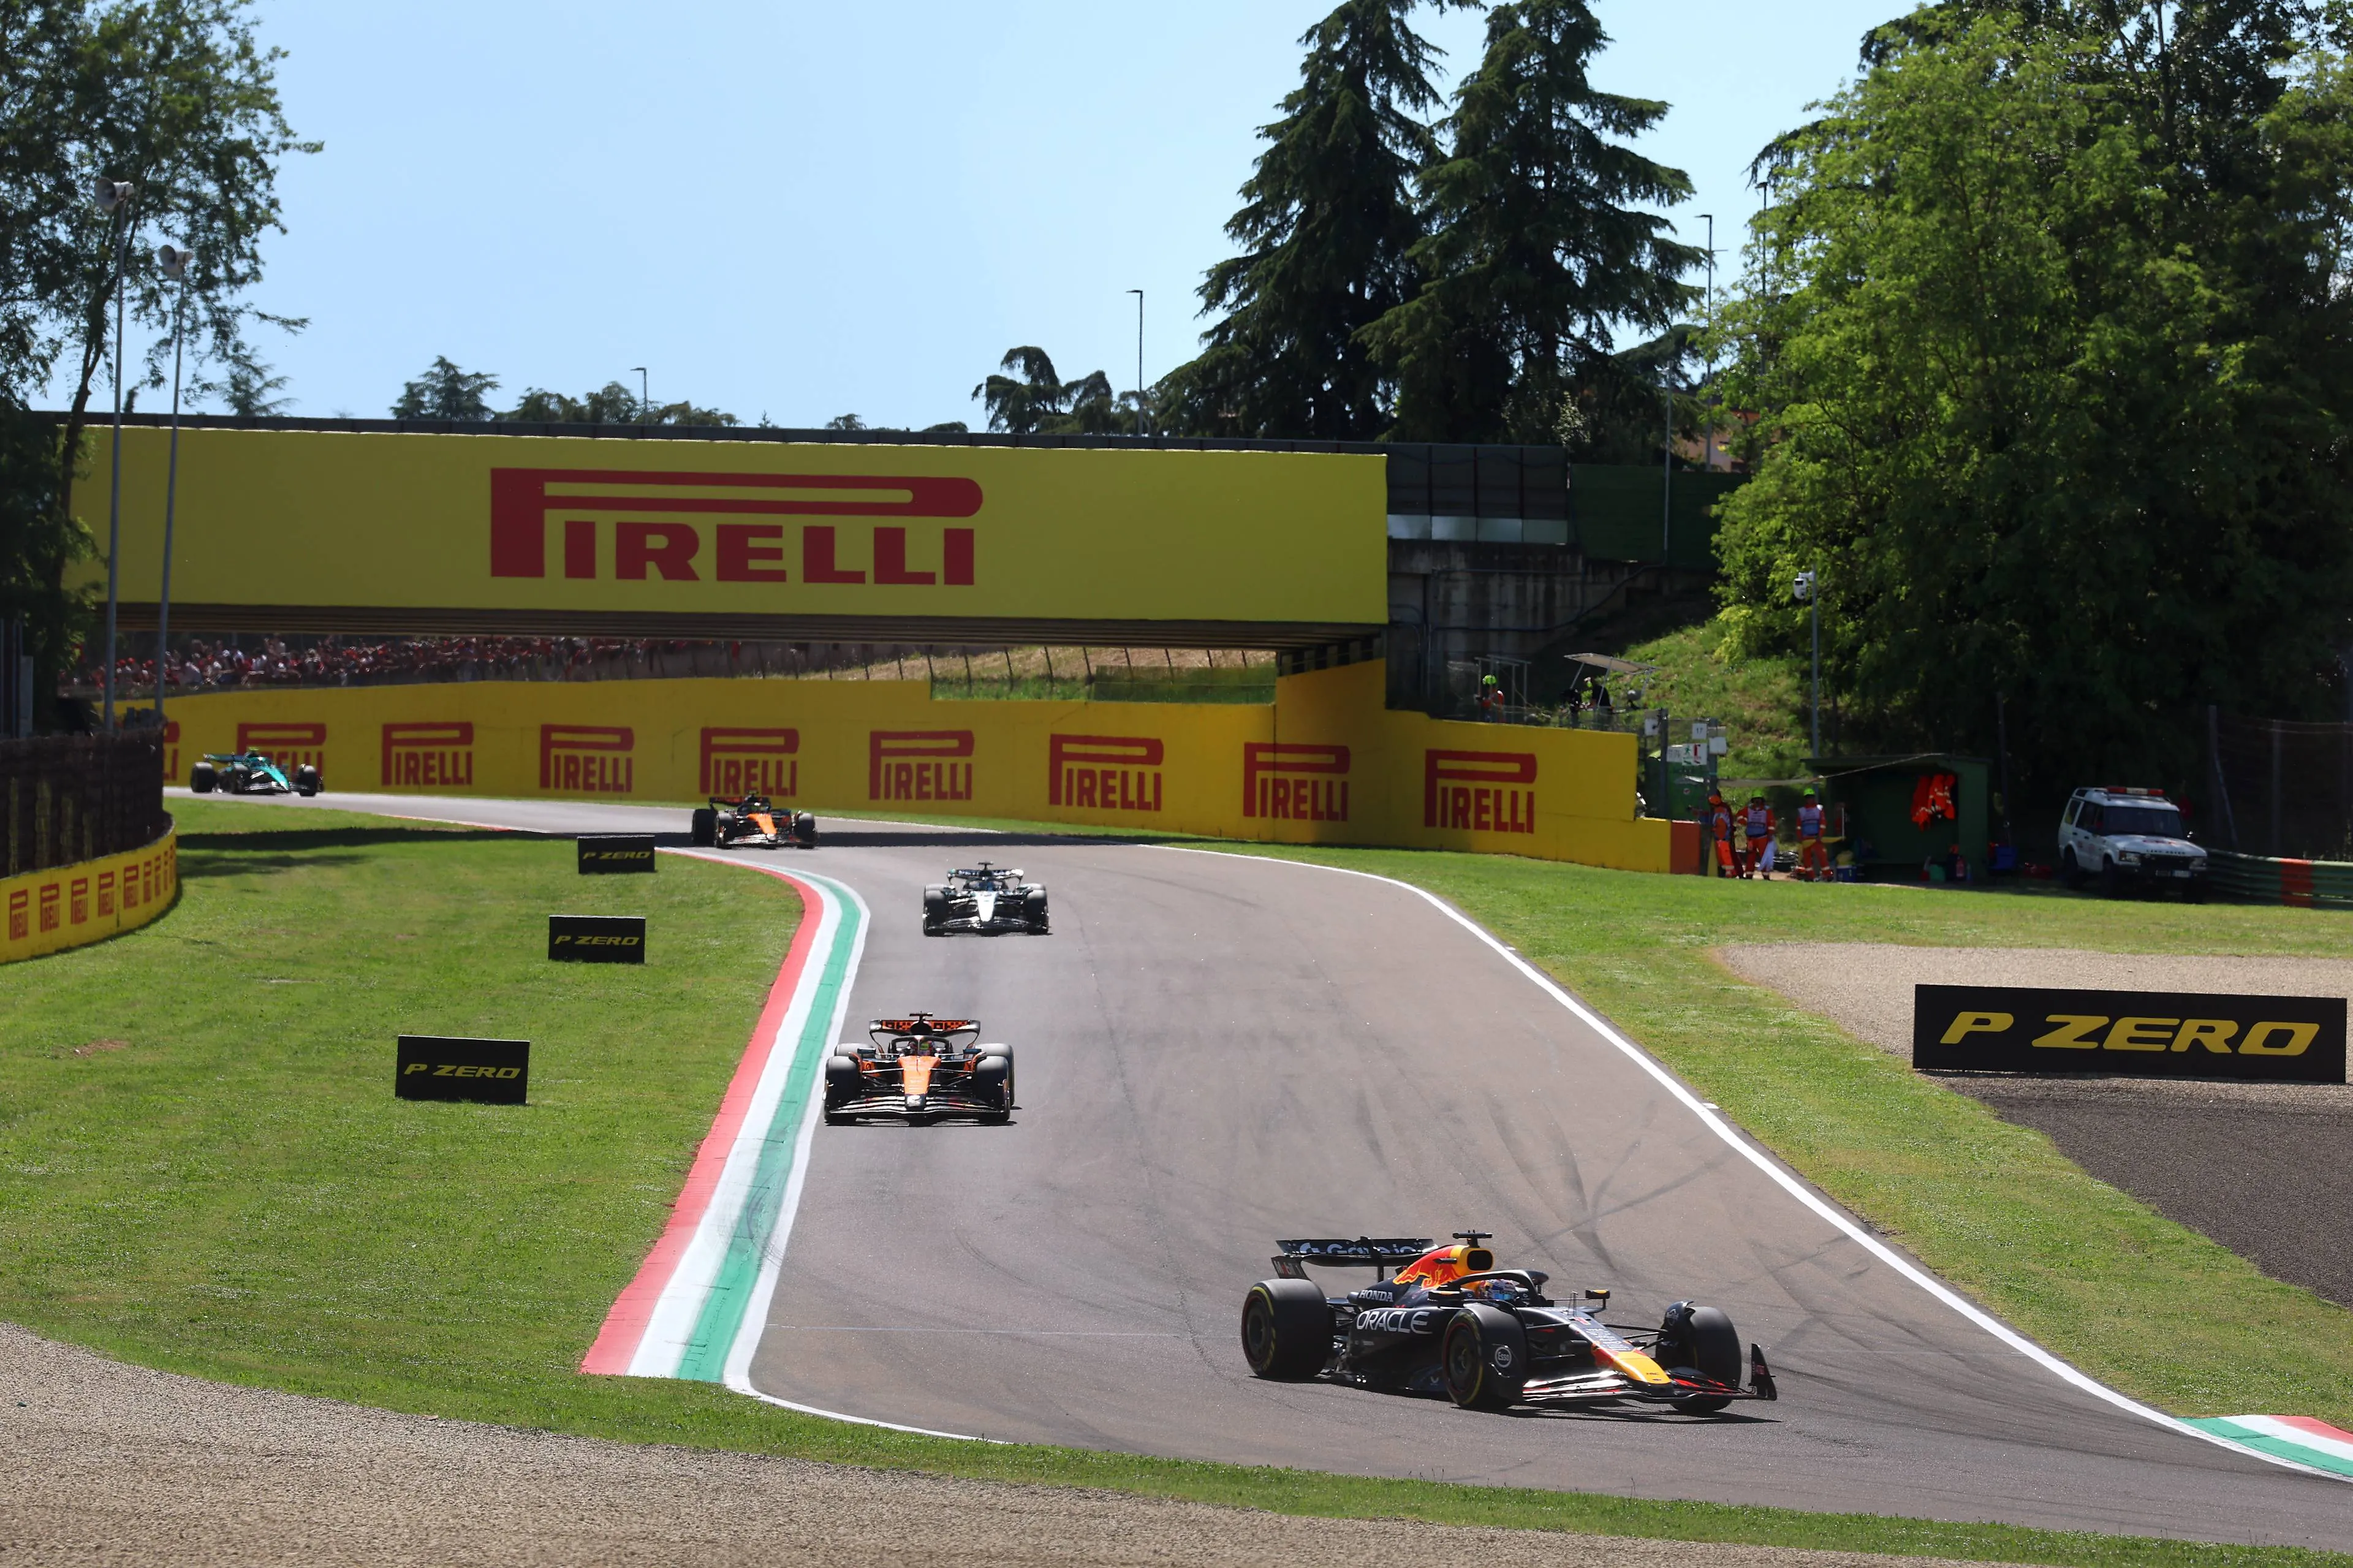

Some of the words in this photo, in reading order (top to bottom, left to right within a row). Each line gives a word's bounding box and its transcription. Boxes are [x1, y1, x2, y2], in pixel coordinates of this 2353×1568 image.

[491, 468, 983, 585] PIRELLI
[382, 722, 474, 786] PIRELLI
[540, 724, 634, 792] PIRELLI
[699, 727, 800, 796] PIRELLI
[870, 730, 975, 800] PIRELLI
[1049, 733, 1164, 812] PIRELLI
[1243, 741, 1351, 822] PIRELLI
[1424, 749, 1537, 834] PIRELLI
[555, 936, 571, 945] P
[575, 936, 640, 945] ZERO
[1940, 1011, 2014, 1044] P
[2031, 1014, 2321, 1056] ZERO
[404, 1063, 428, 1075] P
[433, 1065, 521, 1079] ZERO
[1356, 1311, 1433, 1335] ORACLE
[1358, 1289, 1394, 1302] HONDA
[1498, 1351, 1510, 1362] Esso
